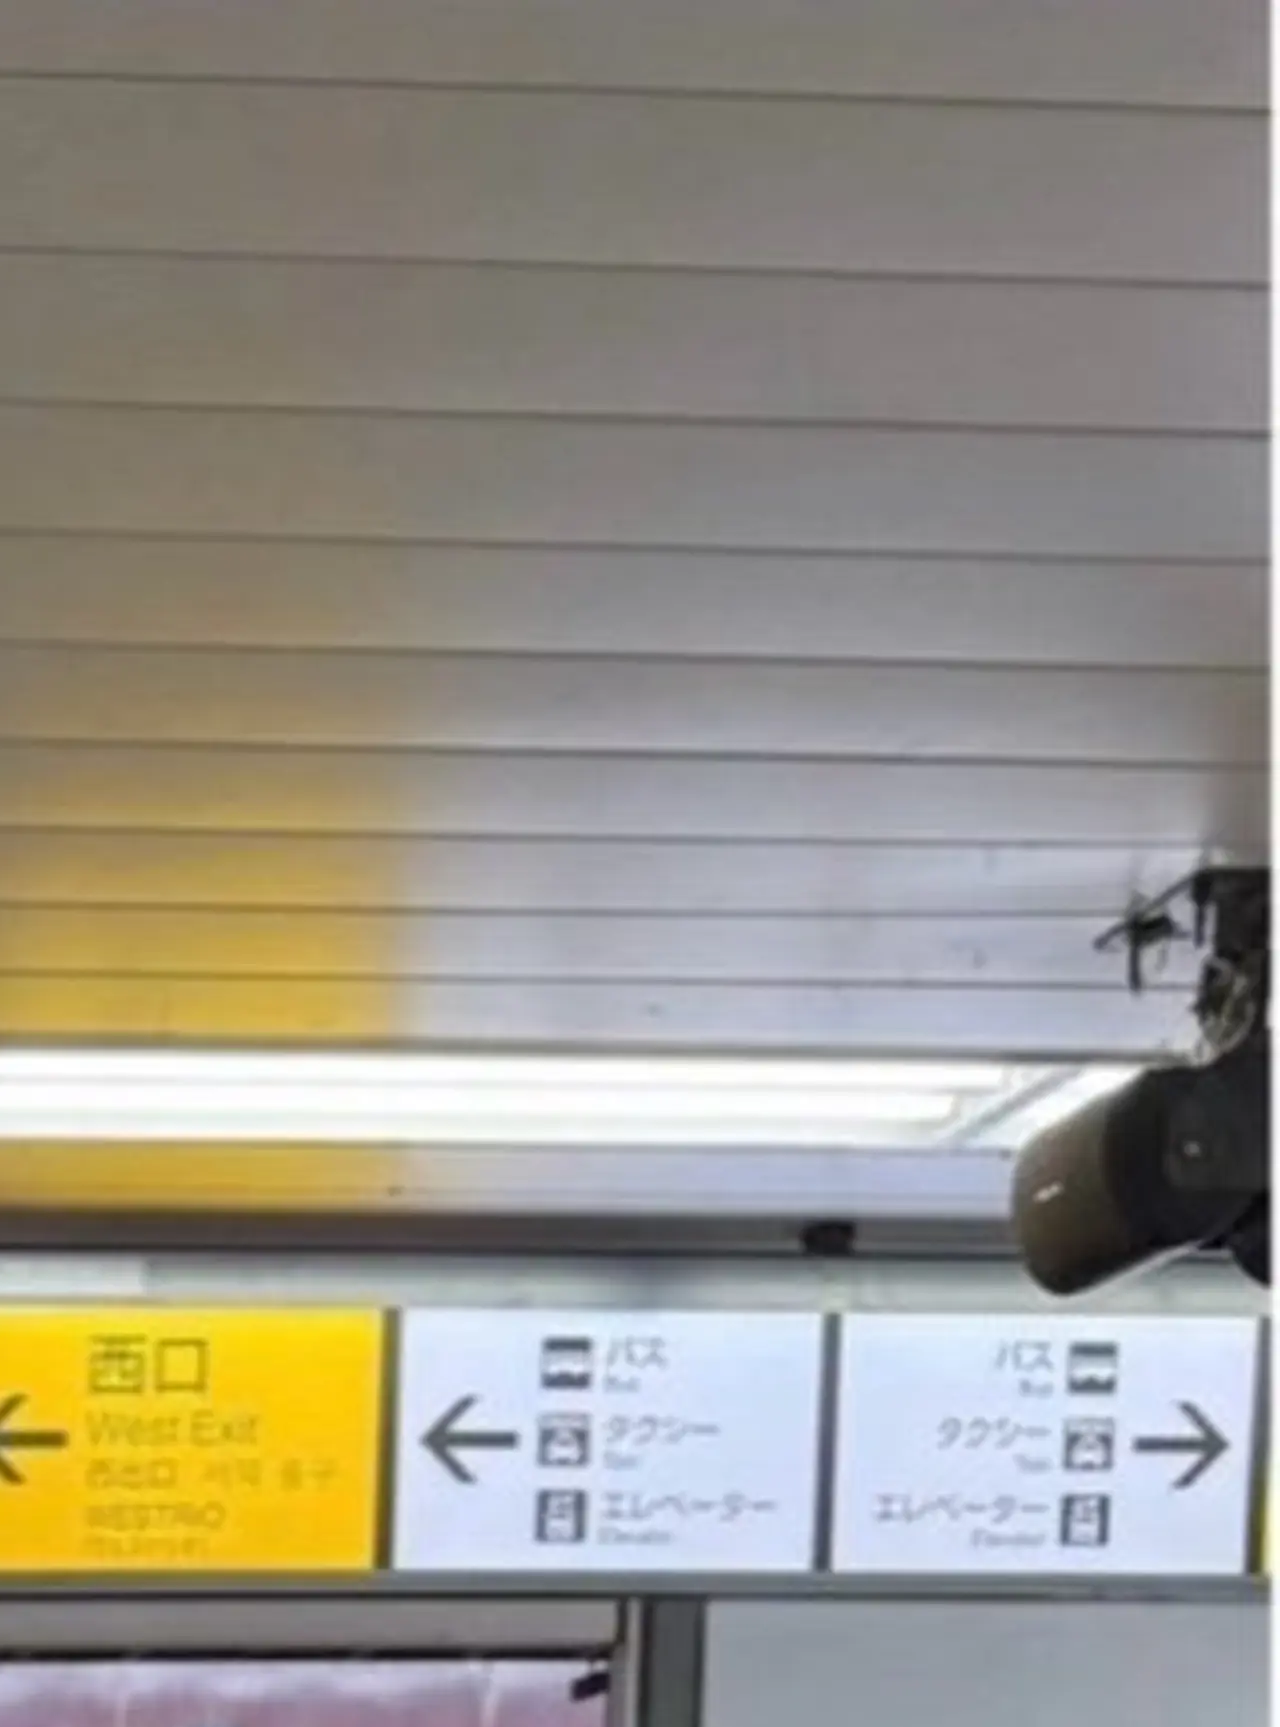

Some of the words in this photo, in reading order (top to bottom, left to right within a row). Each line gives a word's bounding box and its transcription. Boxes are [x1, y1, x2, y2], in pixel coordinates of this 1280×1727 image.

[86, 1333, 210, 1394] 西口
[607, 1336, 668, 1370] バス
[994, 1340, 1054, 1373] バス
[85, 1408, 180, 1447] West
[191, 1407, 260, 1447] Exit
[603, 1413, 721, 1445] タクシー
[937, 1416, 1052, 1450] タクシー
[601, 1491, 776, 1524] エレベーター
[872, 1492, 1051, 1525] エレベーター
